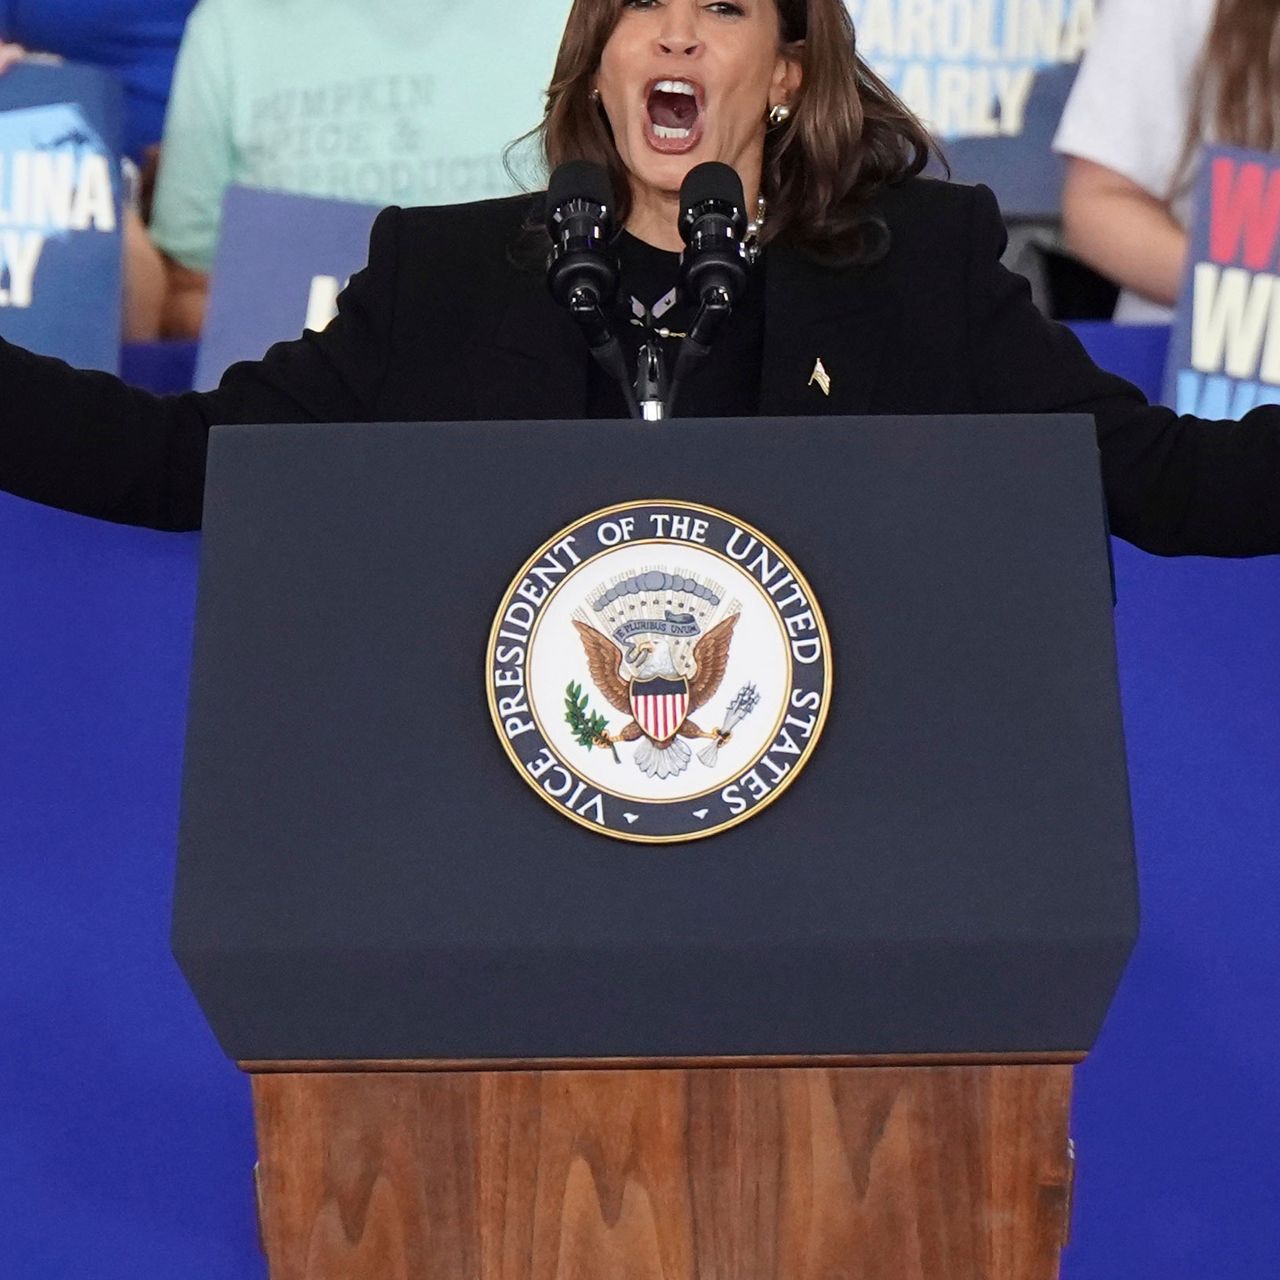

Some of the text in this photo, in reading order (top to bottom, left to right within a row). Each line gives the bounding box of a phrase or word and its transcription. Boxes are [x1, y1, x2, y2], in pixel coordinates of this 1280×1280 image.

[870, 58, 1036, 139] ARLY
[624, 621, 667, 633] PLURIBUS
[495, 513, 822, 825] VICE PRESIDENT OF THE UNITED STATES
